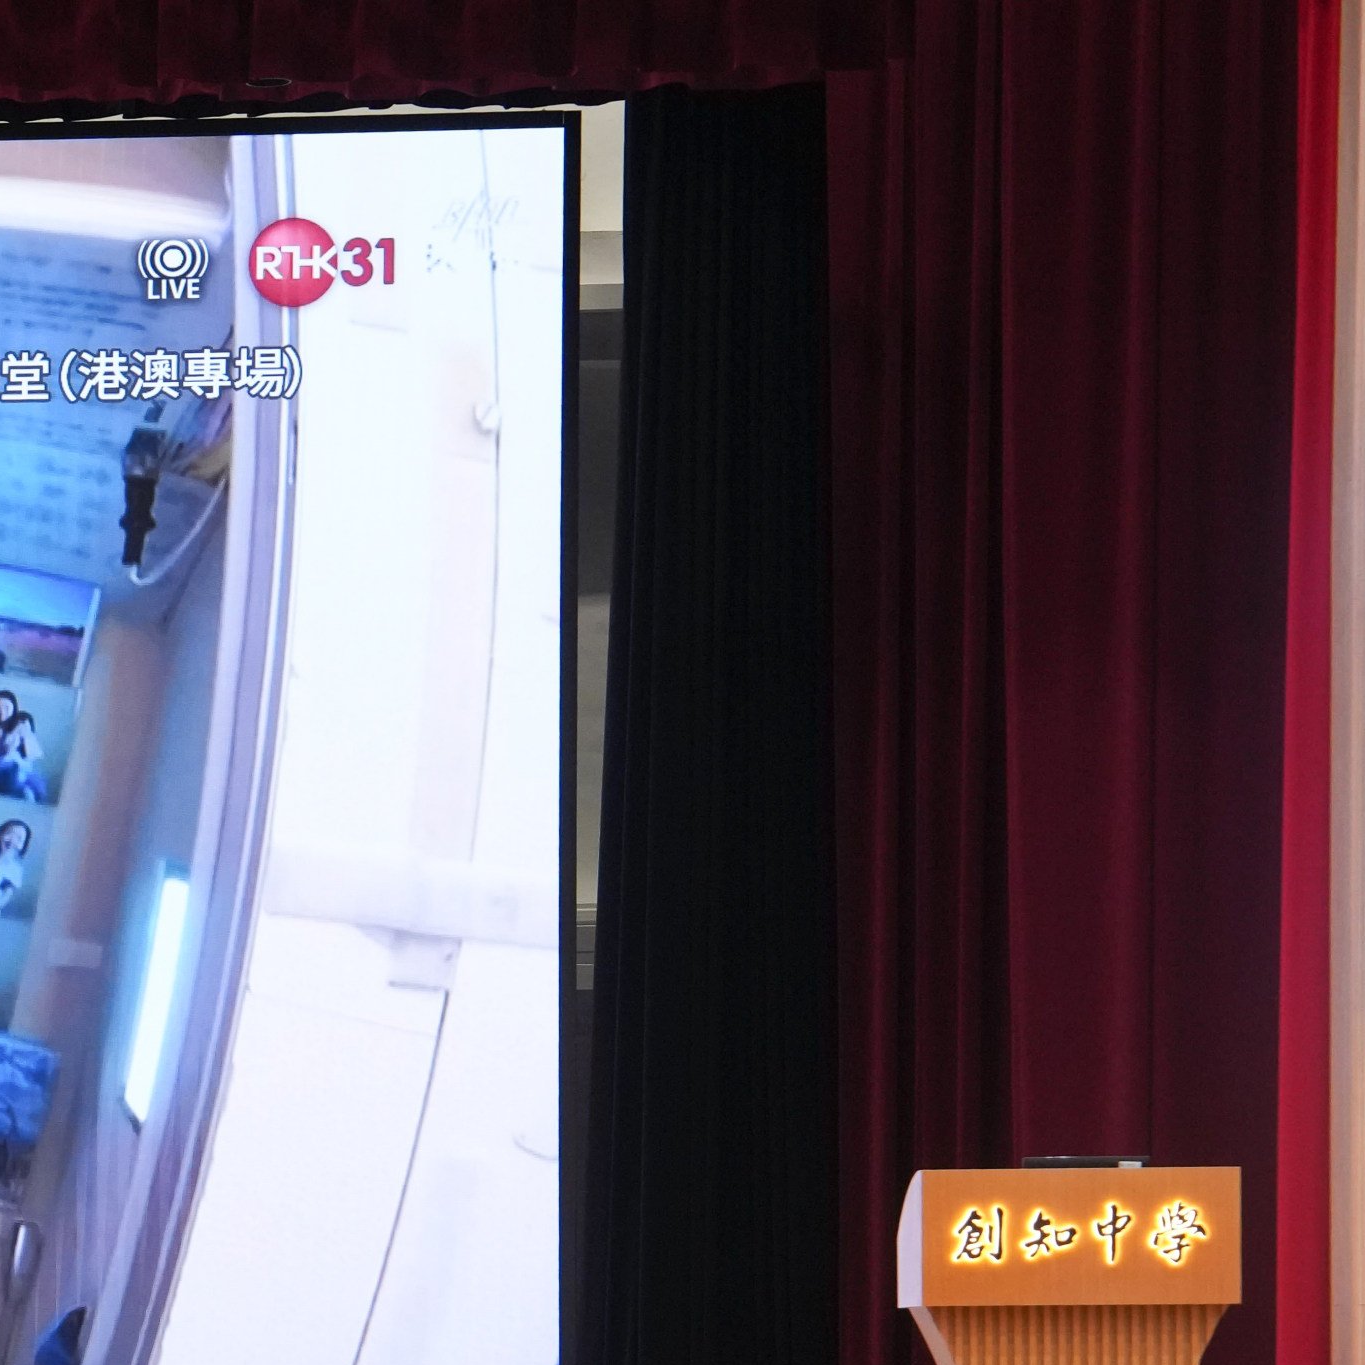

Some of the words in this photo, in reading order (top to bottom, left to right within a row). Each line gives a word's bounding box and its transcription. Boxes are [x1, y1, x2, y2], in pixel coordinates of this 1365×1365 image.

[147, 278, 201, 300] LIVE
[955, 1202, 1208, 1264] 創知中學
